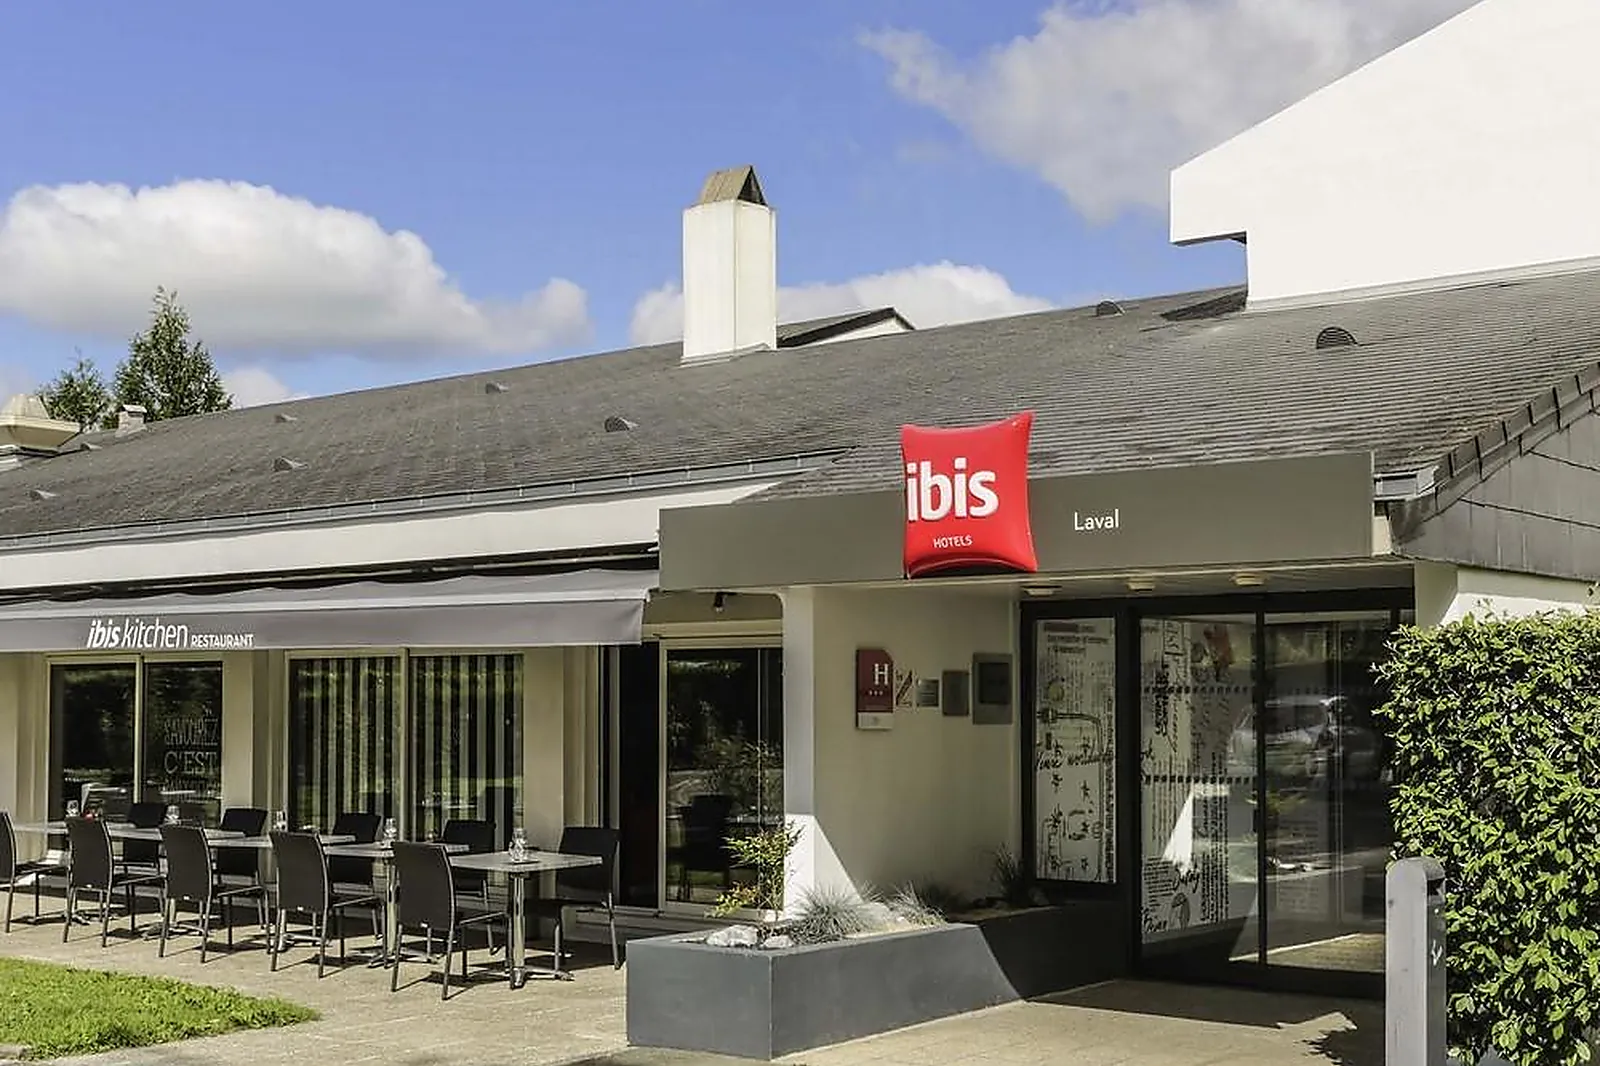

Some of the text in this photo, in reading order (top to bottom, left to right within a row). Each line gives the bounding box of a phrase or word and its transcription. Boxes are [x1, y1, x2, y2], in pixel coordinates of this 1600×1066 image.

[906, 457, 999, 522] ibis
[1074, 508, 1120, 531] Laval
[933, 534, 973, 549] HOTELS
[87, 617, 254, 648] ibis kitchen RESTAURANT
[874, 663, 889, 686] H
